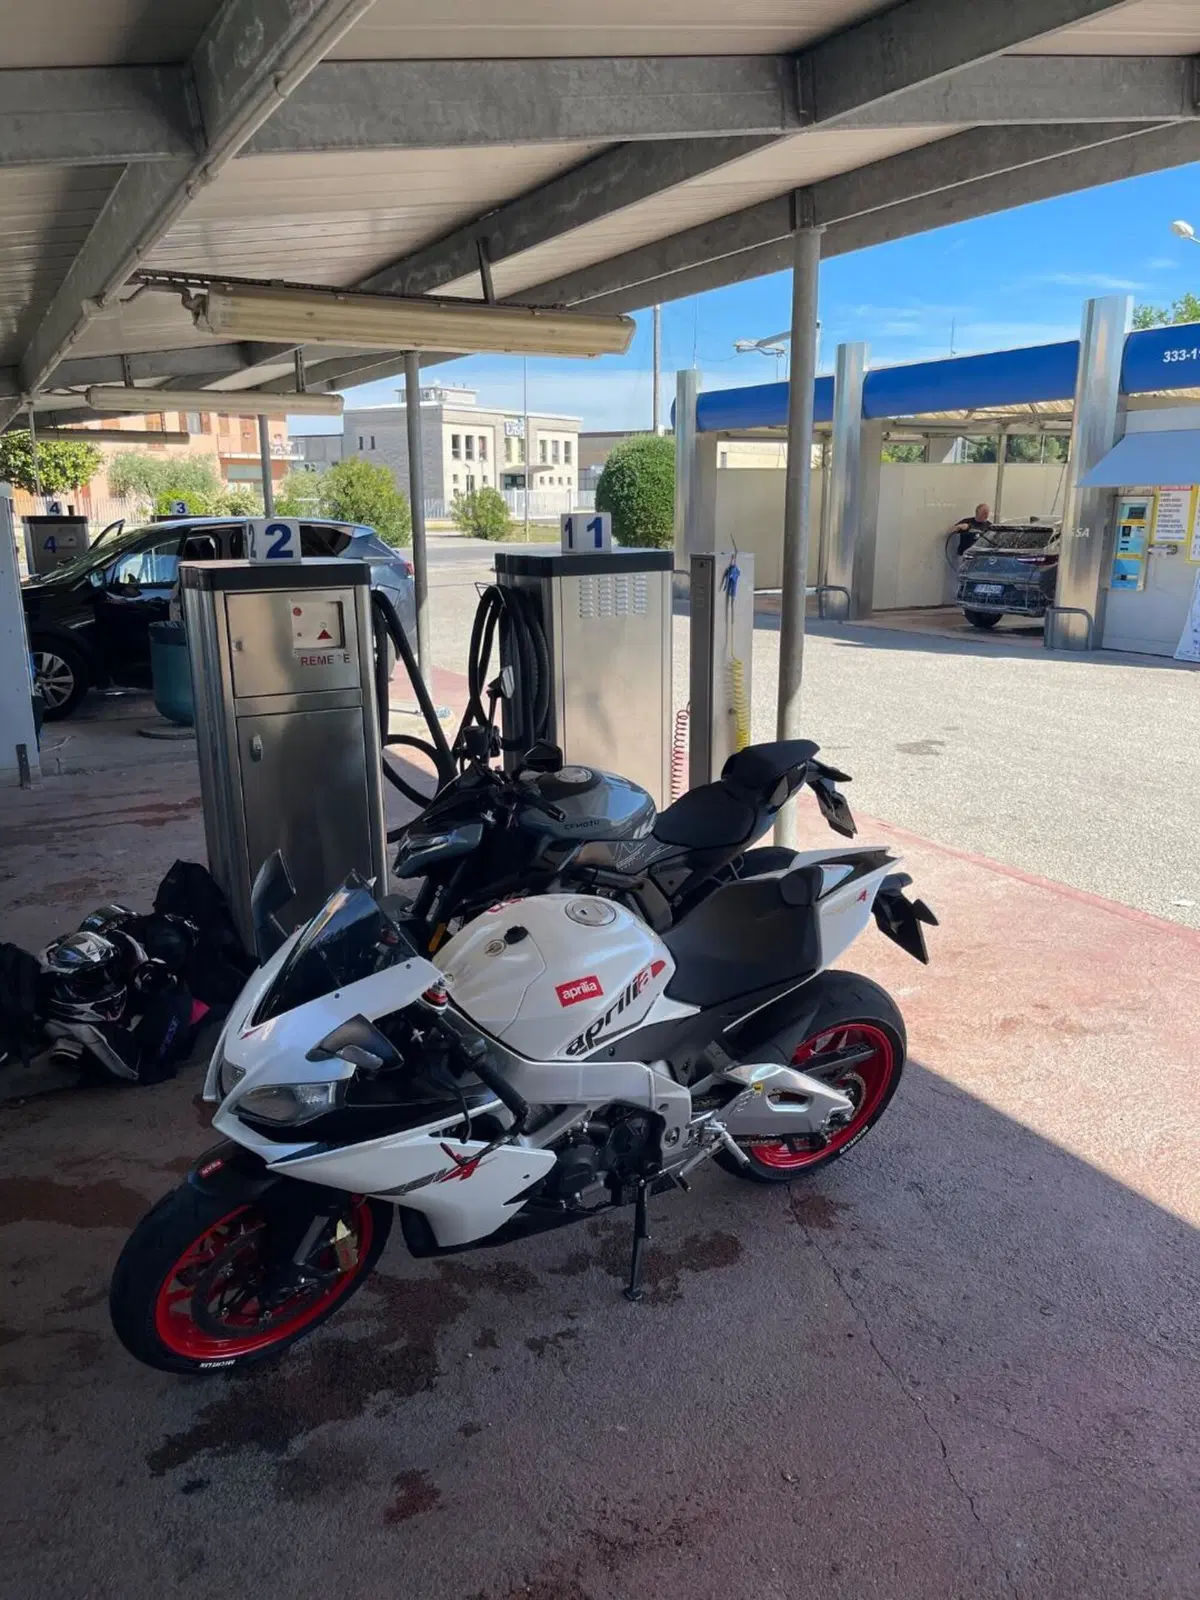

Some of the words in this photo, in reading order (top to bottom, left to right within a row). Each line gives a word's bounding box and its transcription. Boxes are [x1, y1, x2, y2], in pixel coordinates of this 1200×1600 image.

[1163, 348, 1200, 363] 333-1
[50, 502, 60, 514] 4
[176, 502, 187, 514] 3
[586, 516, 603, 548] 1
[44, 536, 57, 553] 4
[265, 524, 294, 559] 2
[561, 981, 598, 1001] aprilia
